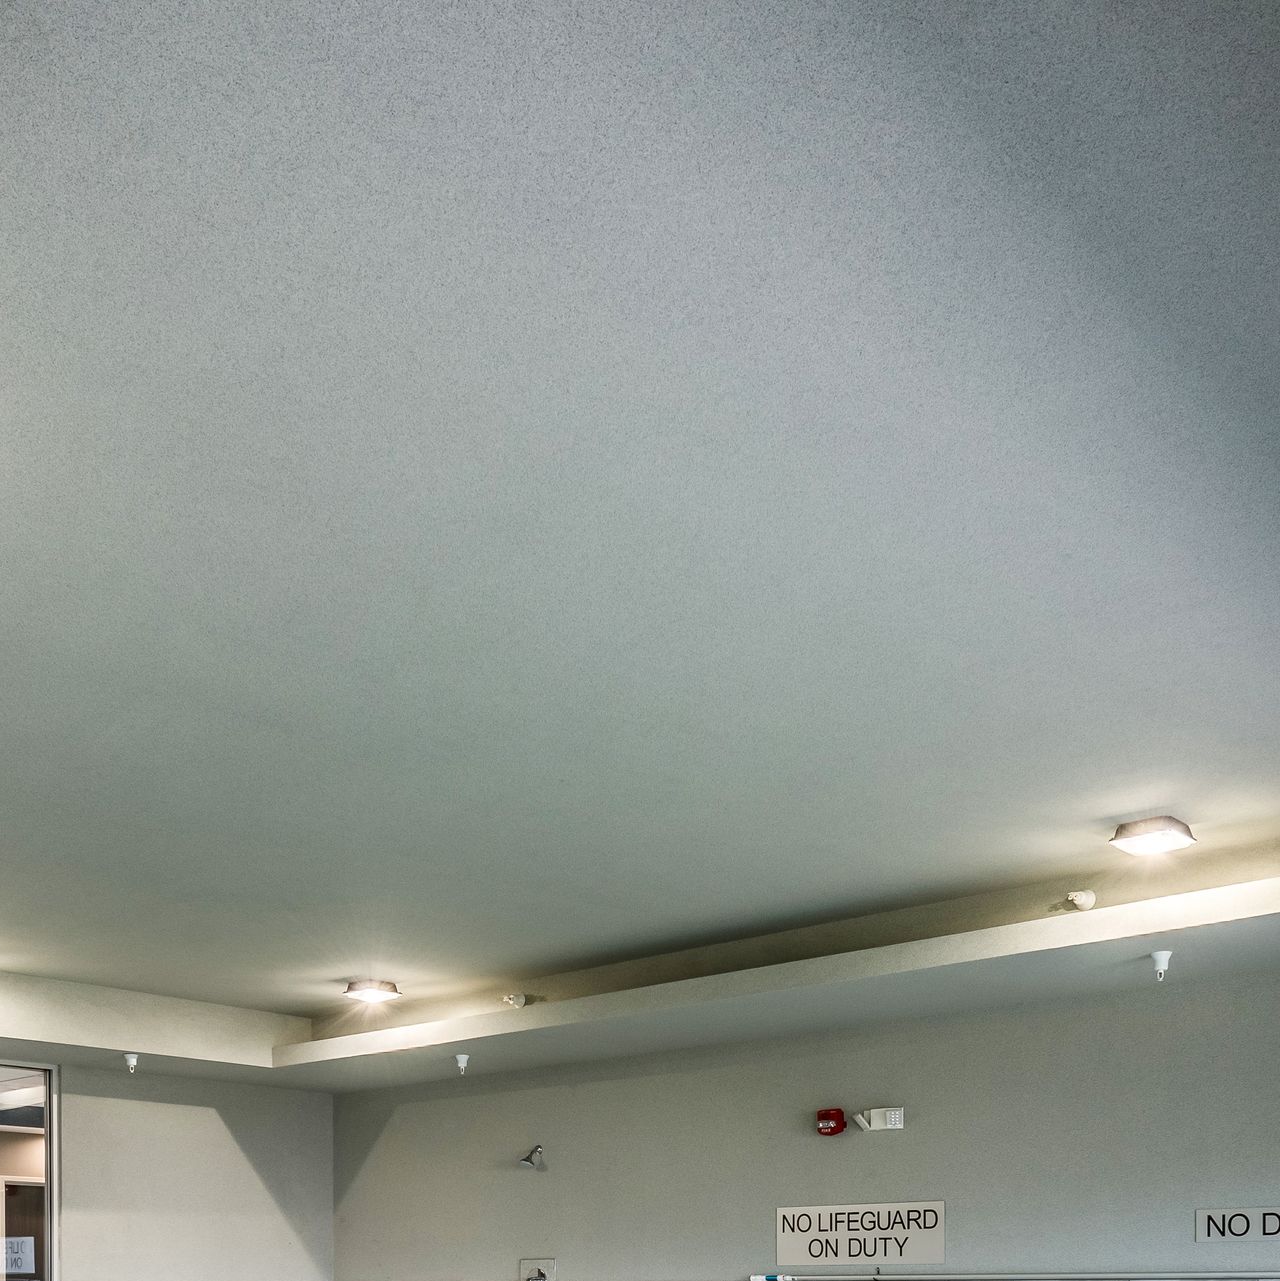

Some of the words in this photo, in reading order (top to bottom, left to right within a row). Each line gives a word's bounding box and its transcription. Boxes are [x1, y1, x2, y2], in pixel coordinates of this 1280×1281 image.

[782, 1213, 812, 1233] NO
[818, 1209, 939, 1232] LIFEGUARD
[1206, 1213, 1250, 1237] NO
[808, 1238, 838, 1258] ON
[848, 1237, 909, 1257] DUTY
